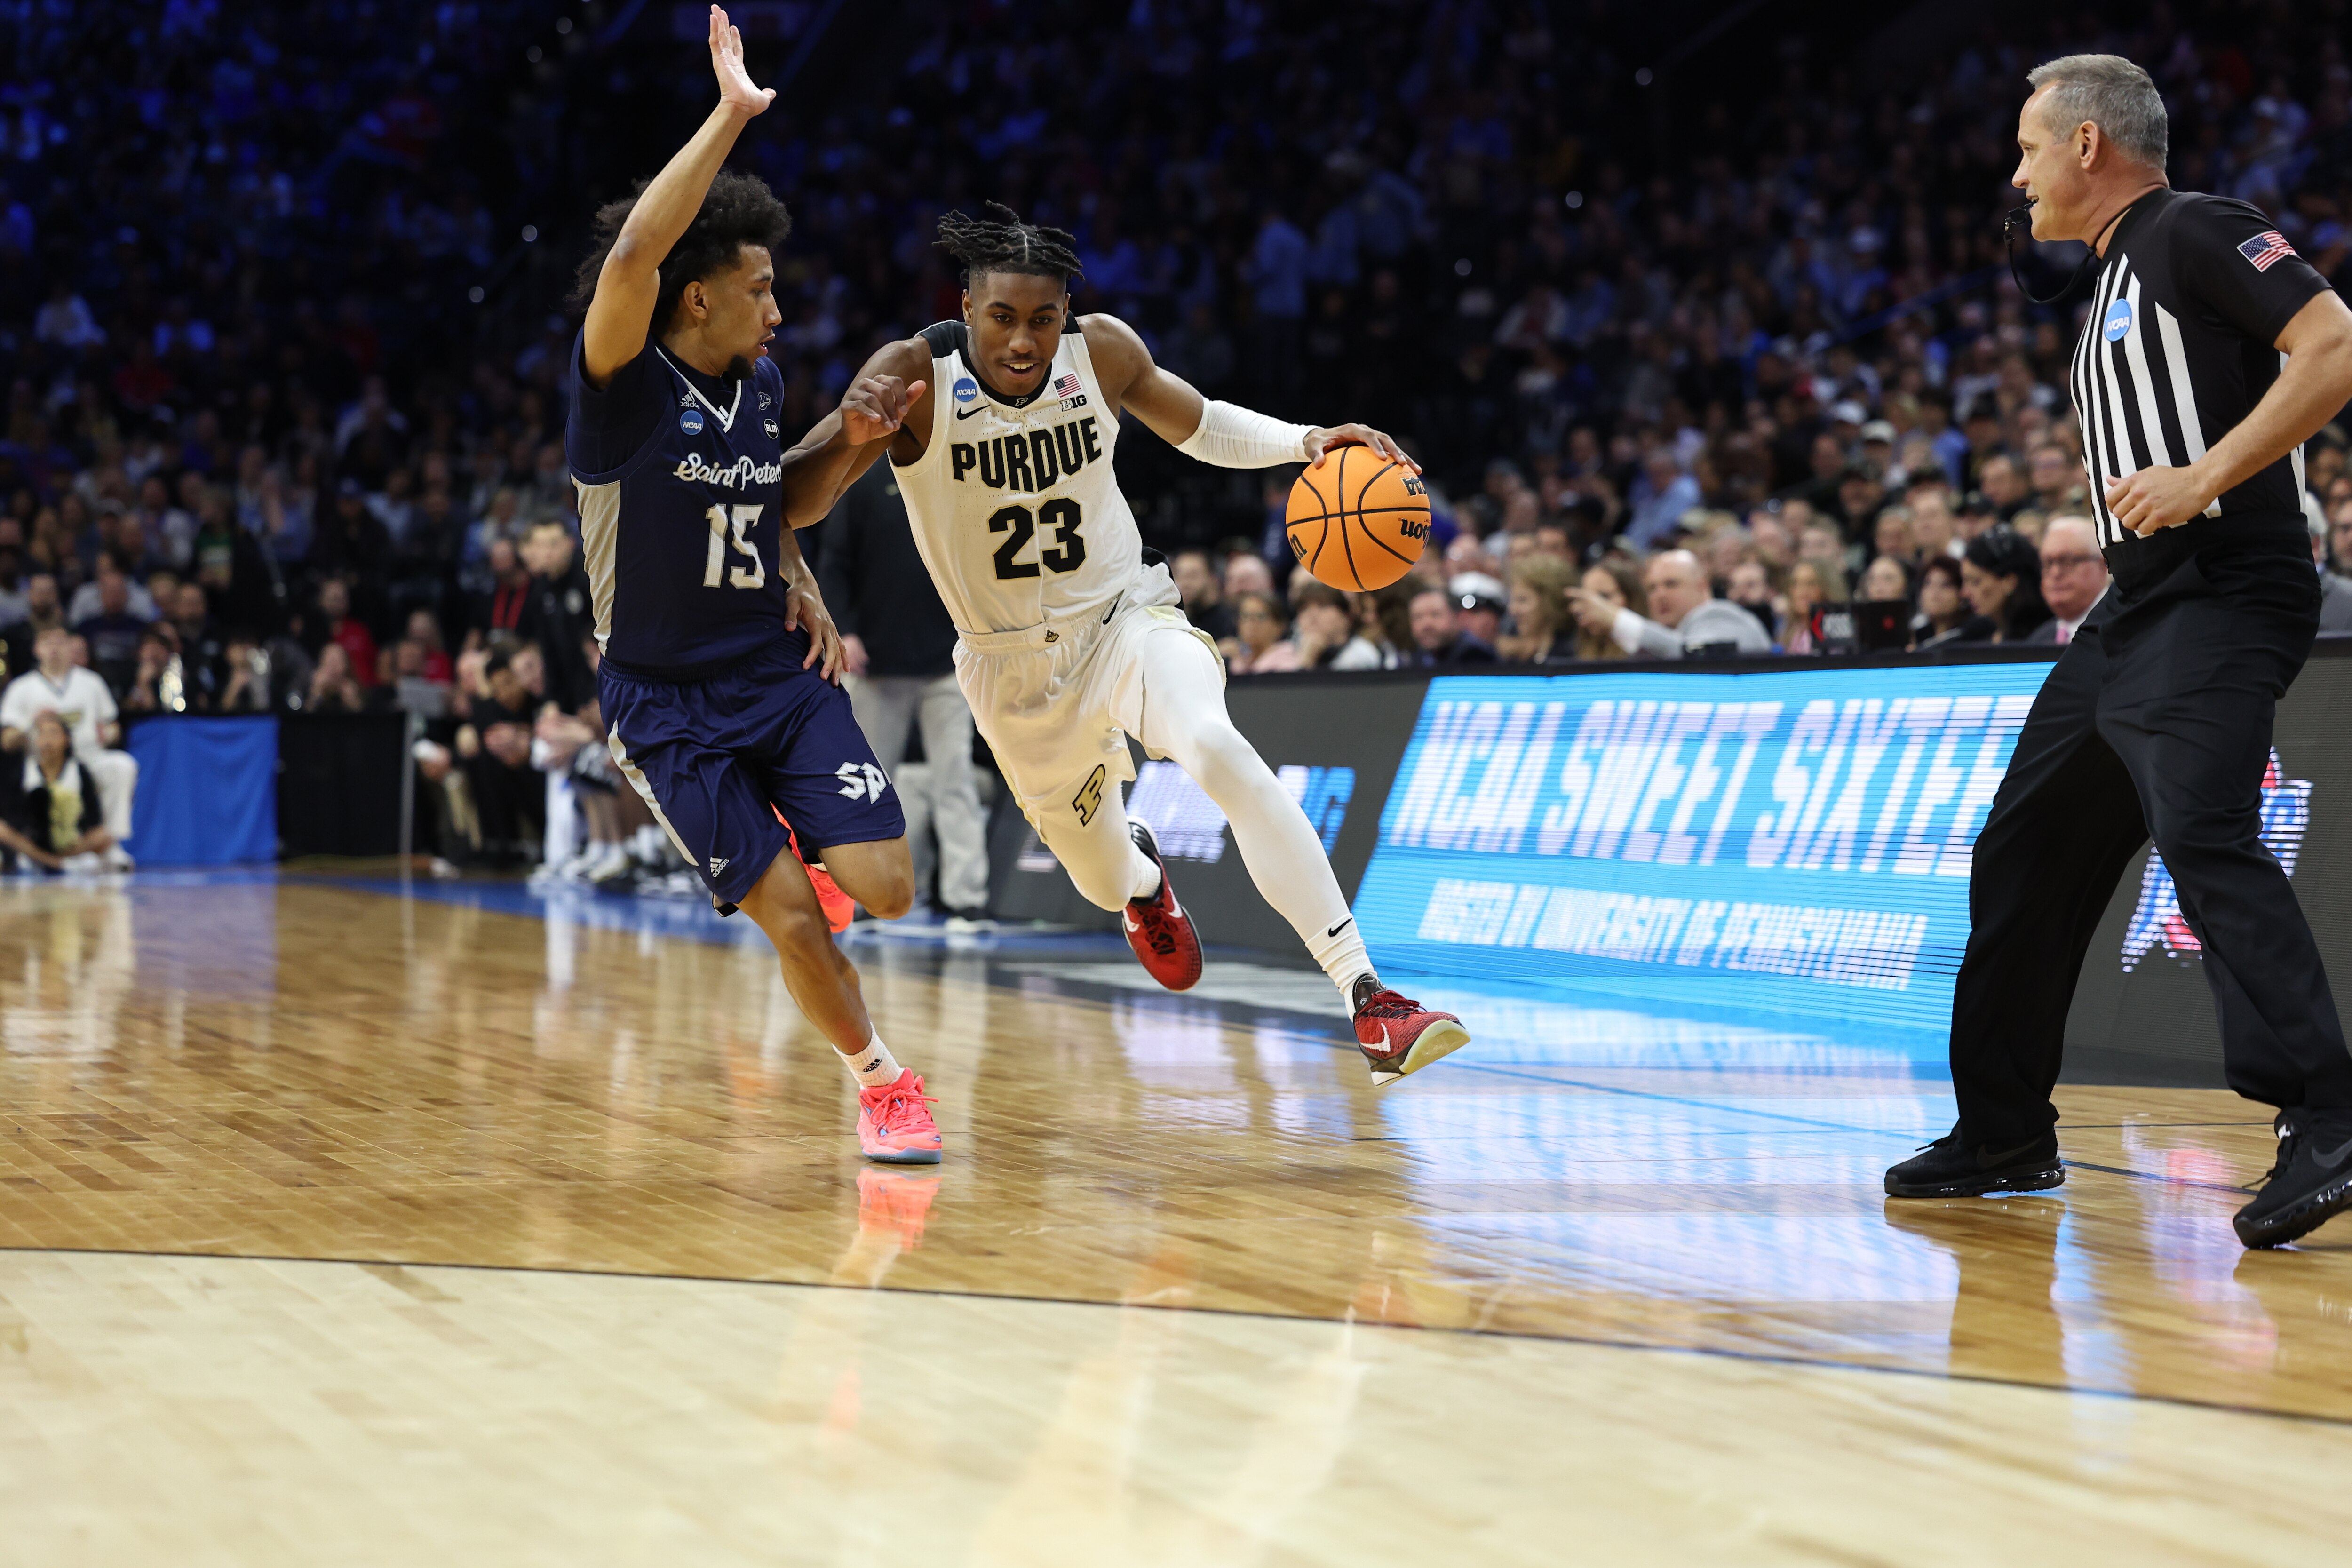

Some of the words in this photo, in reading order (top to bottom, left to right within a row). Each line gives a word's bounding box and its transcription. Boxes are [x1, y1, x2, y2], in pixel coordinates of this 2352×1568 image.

[2106, 316, 2130, 333] NCAA
[1015, 398, 1028, 406] P
[683, 421, 702, 430] NCAA
[765, 423, 778, 434] BLM
[673, 452, 739, 488] Saint
[950, 416, 1102, 494] PURDUE
[703, 502, 766, 589] 15
[987, 497, 1086, 580] 23
[834, 761, 887, 805] SP
[1072, 764, 1106, 827] P
[1389, 700, 1567, 854] NCAA
[1536, 699, 1784, 866] SWEET
[1746, 694, 2037, 876] SIXTEE
[712, 858, 730, 878] adidas
[1417, 878, 1516, 945] HOSTED
[1499, 883, 1551, 949] BY
[1532, 886, 1693, 964] UNIVERSITY
[1675, 899, 1728, 967] OF
[1710, 901, 1928, 992] PENNSYLVANIA
